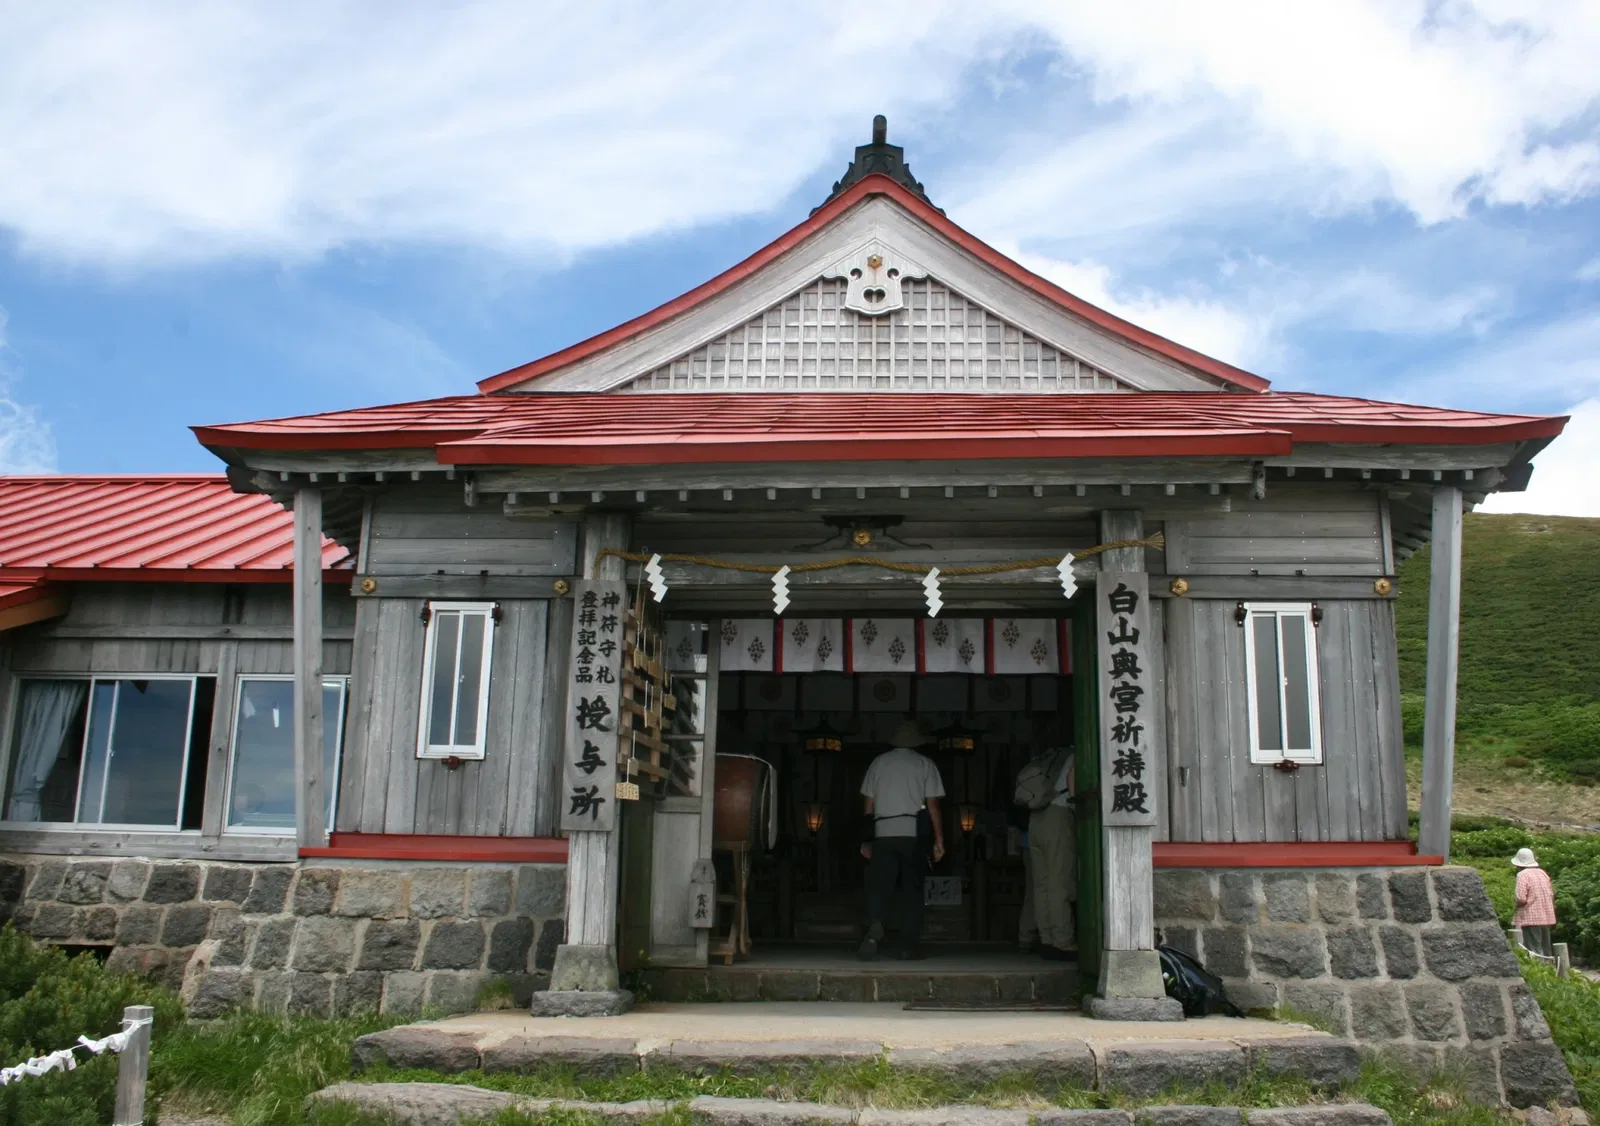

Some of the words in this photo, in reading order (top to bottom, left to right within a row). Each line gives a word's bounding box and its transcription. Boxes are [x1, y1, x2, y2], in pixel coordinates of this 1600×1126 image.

[575, 590, 598, 684] 登拝記念品
[596, 591, 620, 684] 神符守札
[569, 695, 611, 816] 授与所
